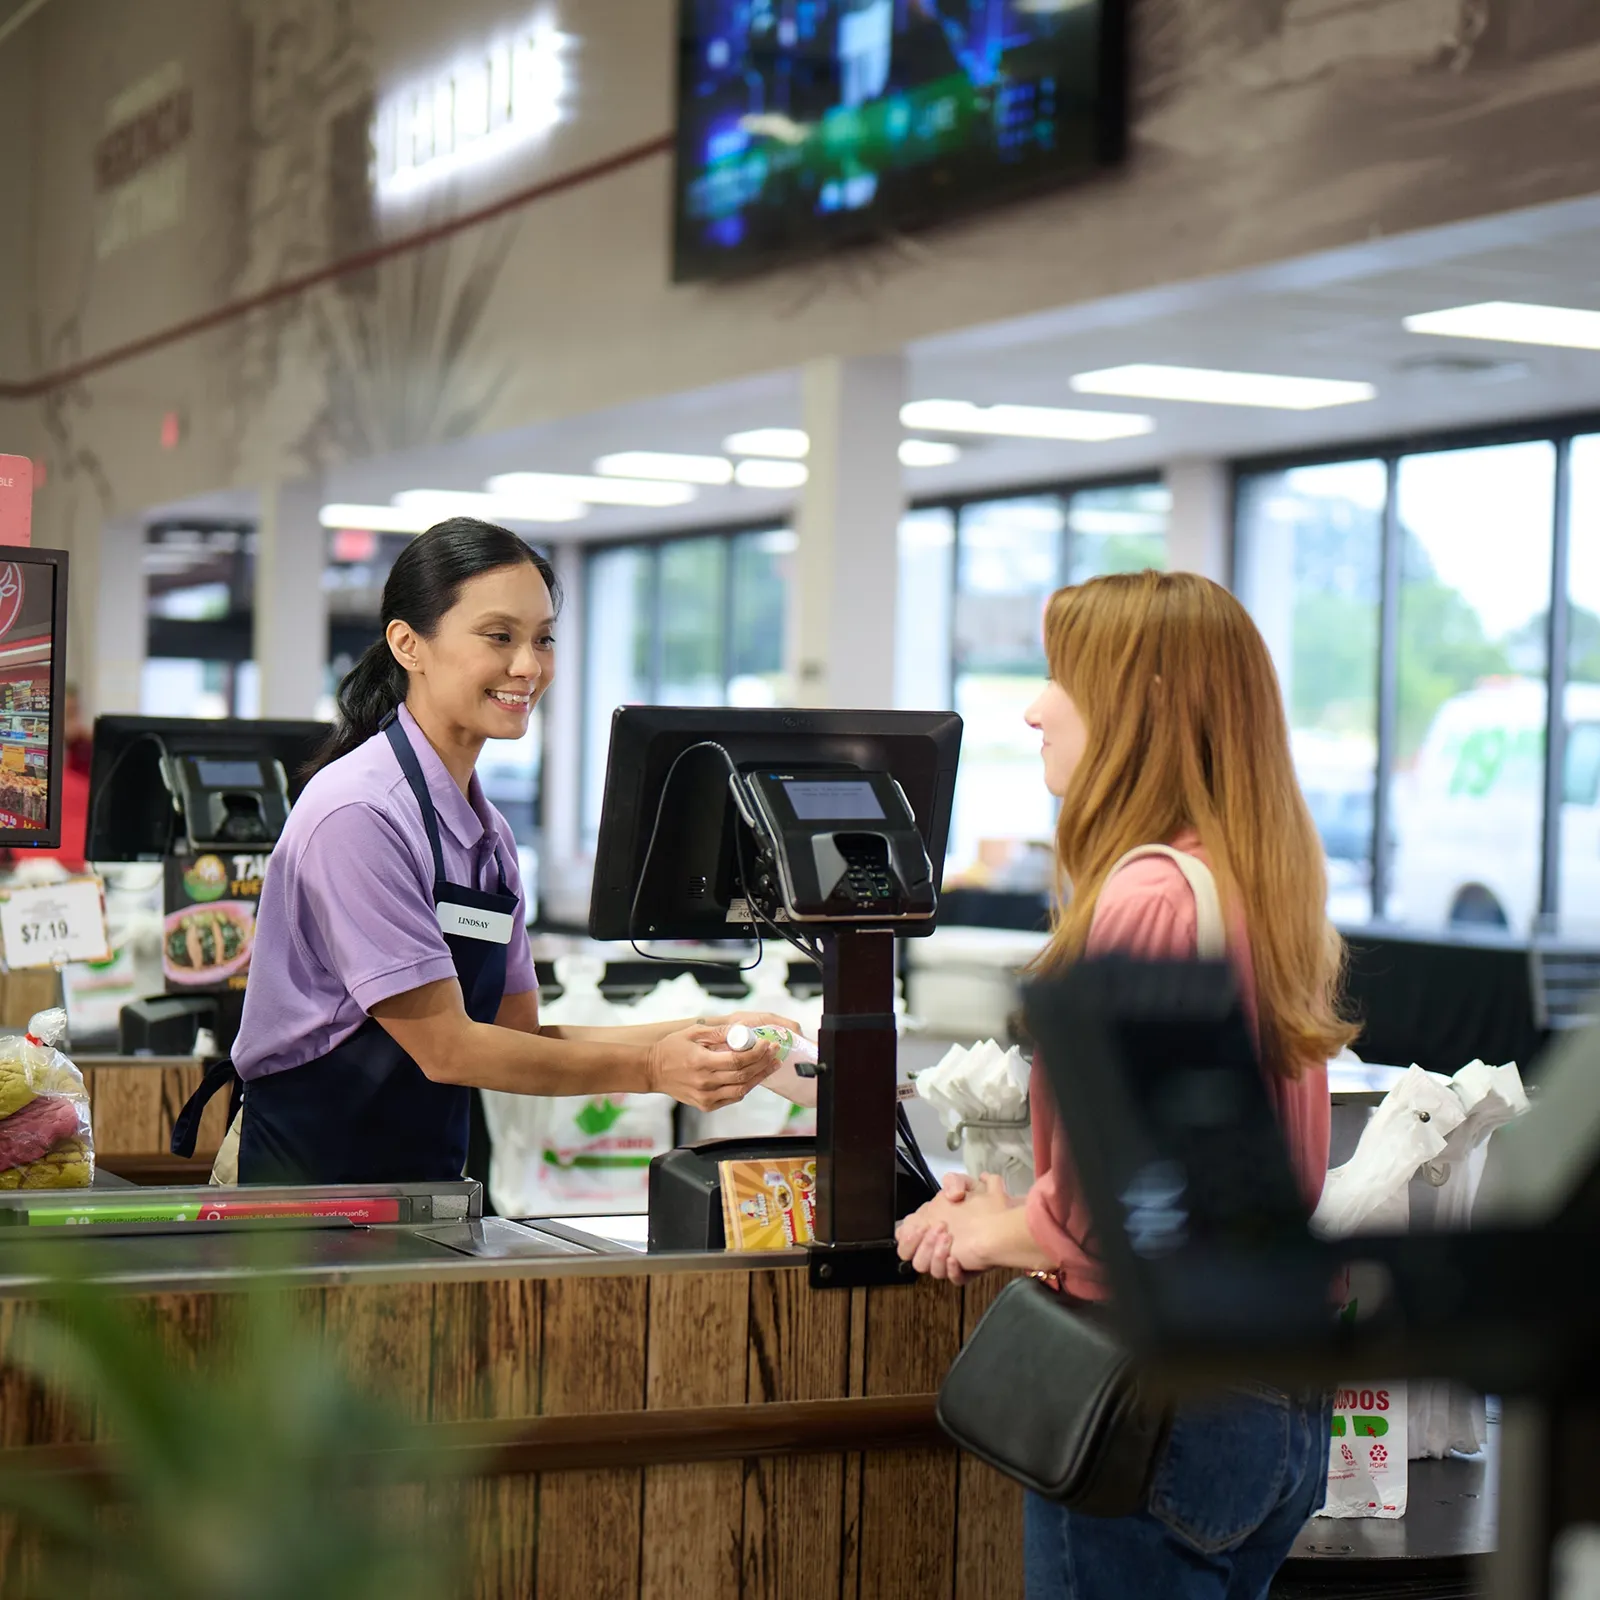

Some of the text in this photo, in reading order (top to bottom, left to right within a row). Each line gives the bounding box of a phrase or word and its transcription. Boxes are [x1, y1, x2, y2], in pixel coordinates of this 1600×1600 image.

[232, 854, 269, 880] TA
[231, 879, 263, 897] TUE
[20, 919, 69, 944] $7.19
[458, 917, 489, 928] LINDSAY
